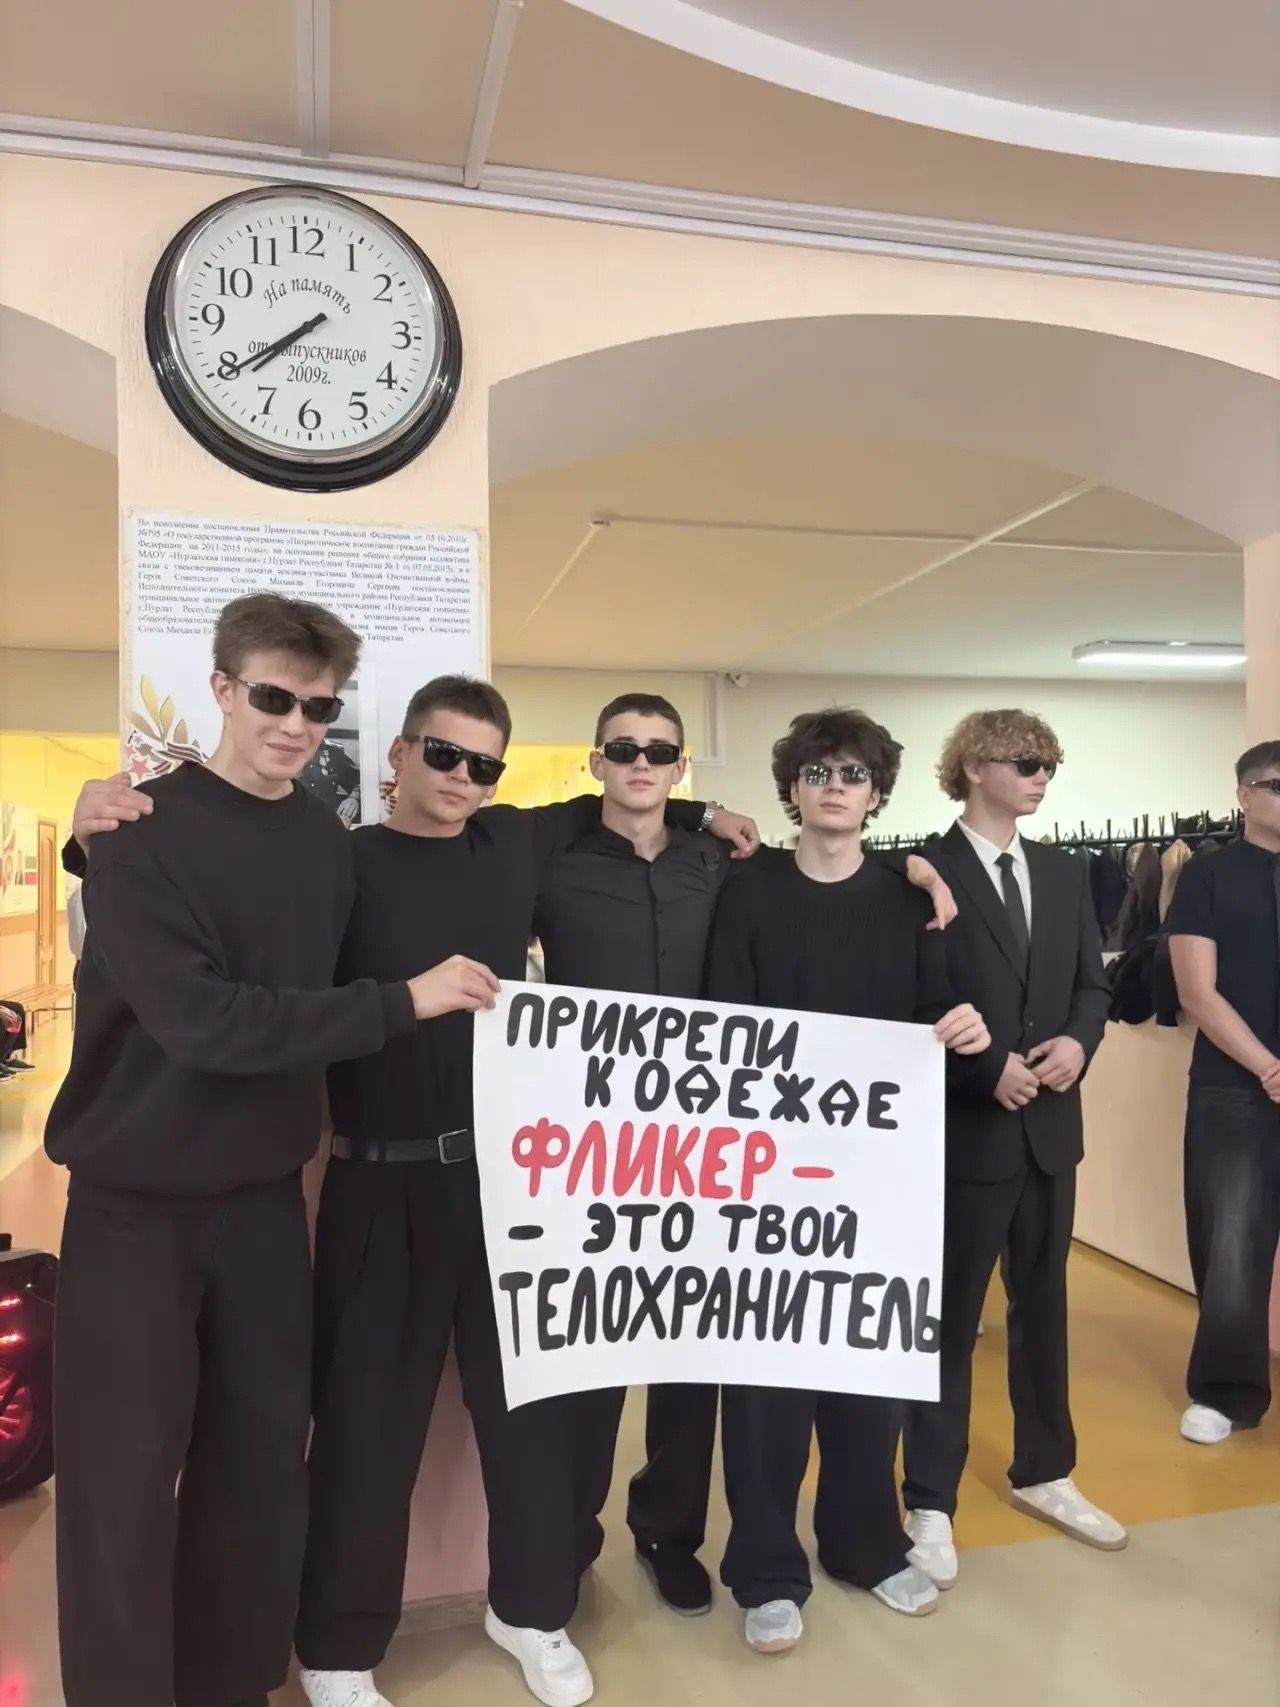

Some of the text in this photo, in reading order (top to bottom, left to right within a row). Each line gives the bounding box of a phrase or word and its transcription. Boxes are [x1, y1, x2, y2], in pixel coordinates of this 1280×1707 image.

[249, 236, 280, 266] 11
[288, 226, 325, 258] 12
[345, 243, 359, 272] 1
[216, 267, 253, 298] 10
[263, 276, 351, 314] На память
[373, 274, 392, 302] 2
[201, 303, 225, 336] 9
[392, 321, 411, 349] 3
[217, 351, 240, 380] 8
[278, 342, 367, 366] ыпускников
[286, 365, 331, 385] 2009г.
[376, 360, 397, 389] 4
[257, 385, 277, 415] 7
[298, 399, 321, 430] 6
[348, 391, 368, 420] 5
[176, 533, 242, 541] государственной
[396, 544, 426, 552] граждан
[428, 544, 470, 553] Российской
[264, 525, 319, 536] Правительства
[323, 528, 367, 538] Российской
[370, 531, 411, 542] Федерации
[138, 540, 182, 550] Федерации
[201, 543, 241, 552] 2011-2015
[363, 551, 390, 561] общего
[393, 553, 427, 562] собрания
[430, 556, 470, 564] коллектива
[138, 550, 166, 559] МАОУ
[299, 558, 343, 568] Республики
[346, 560, 382, 570] Татарстан
[138, 571, 161, 581] Героя
[174, 573, 219, 582] Советского
[231, 576, 256, 584] Союза
[269, 577, 304, 586] Михаила
[316, 580, 355, 590] Егоровича
[367, 582, 400, 592] Сергеева
[351, 571, 383, 580] Великой
[387, 572, 441, 582] Отечественной
[138, 582, 208, 592] Исполнительного
[298, 591, 360, 599] муниципального
[362, 592, 388, 601] района
[389, 593, 433, 603] Республики
[435, 595, 471, 605] Татарстан
[138, 594, 199, 602] муниципальное
[138, 624, 164, 633] Союза
[403, 624, 425, 634] Героя
[506, 993, 799, 1071] ПРИКРЕПИ
[585, 1055, 900, 1130] К ОДЕЖДЕ
[512, 1117, 776, 1200] ФЛИКЕР
[582, 1202, 694, 1253] ЭТО
[719, 1204, 858, 1259] ТВОЙ
[499, 1265, 940, 1357] ТЕЛОХРАНИТЕЛЬ
